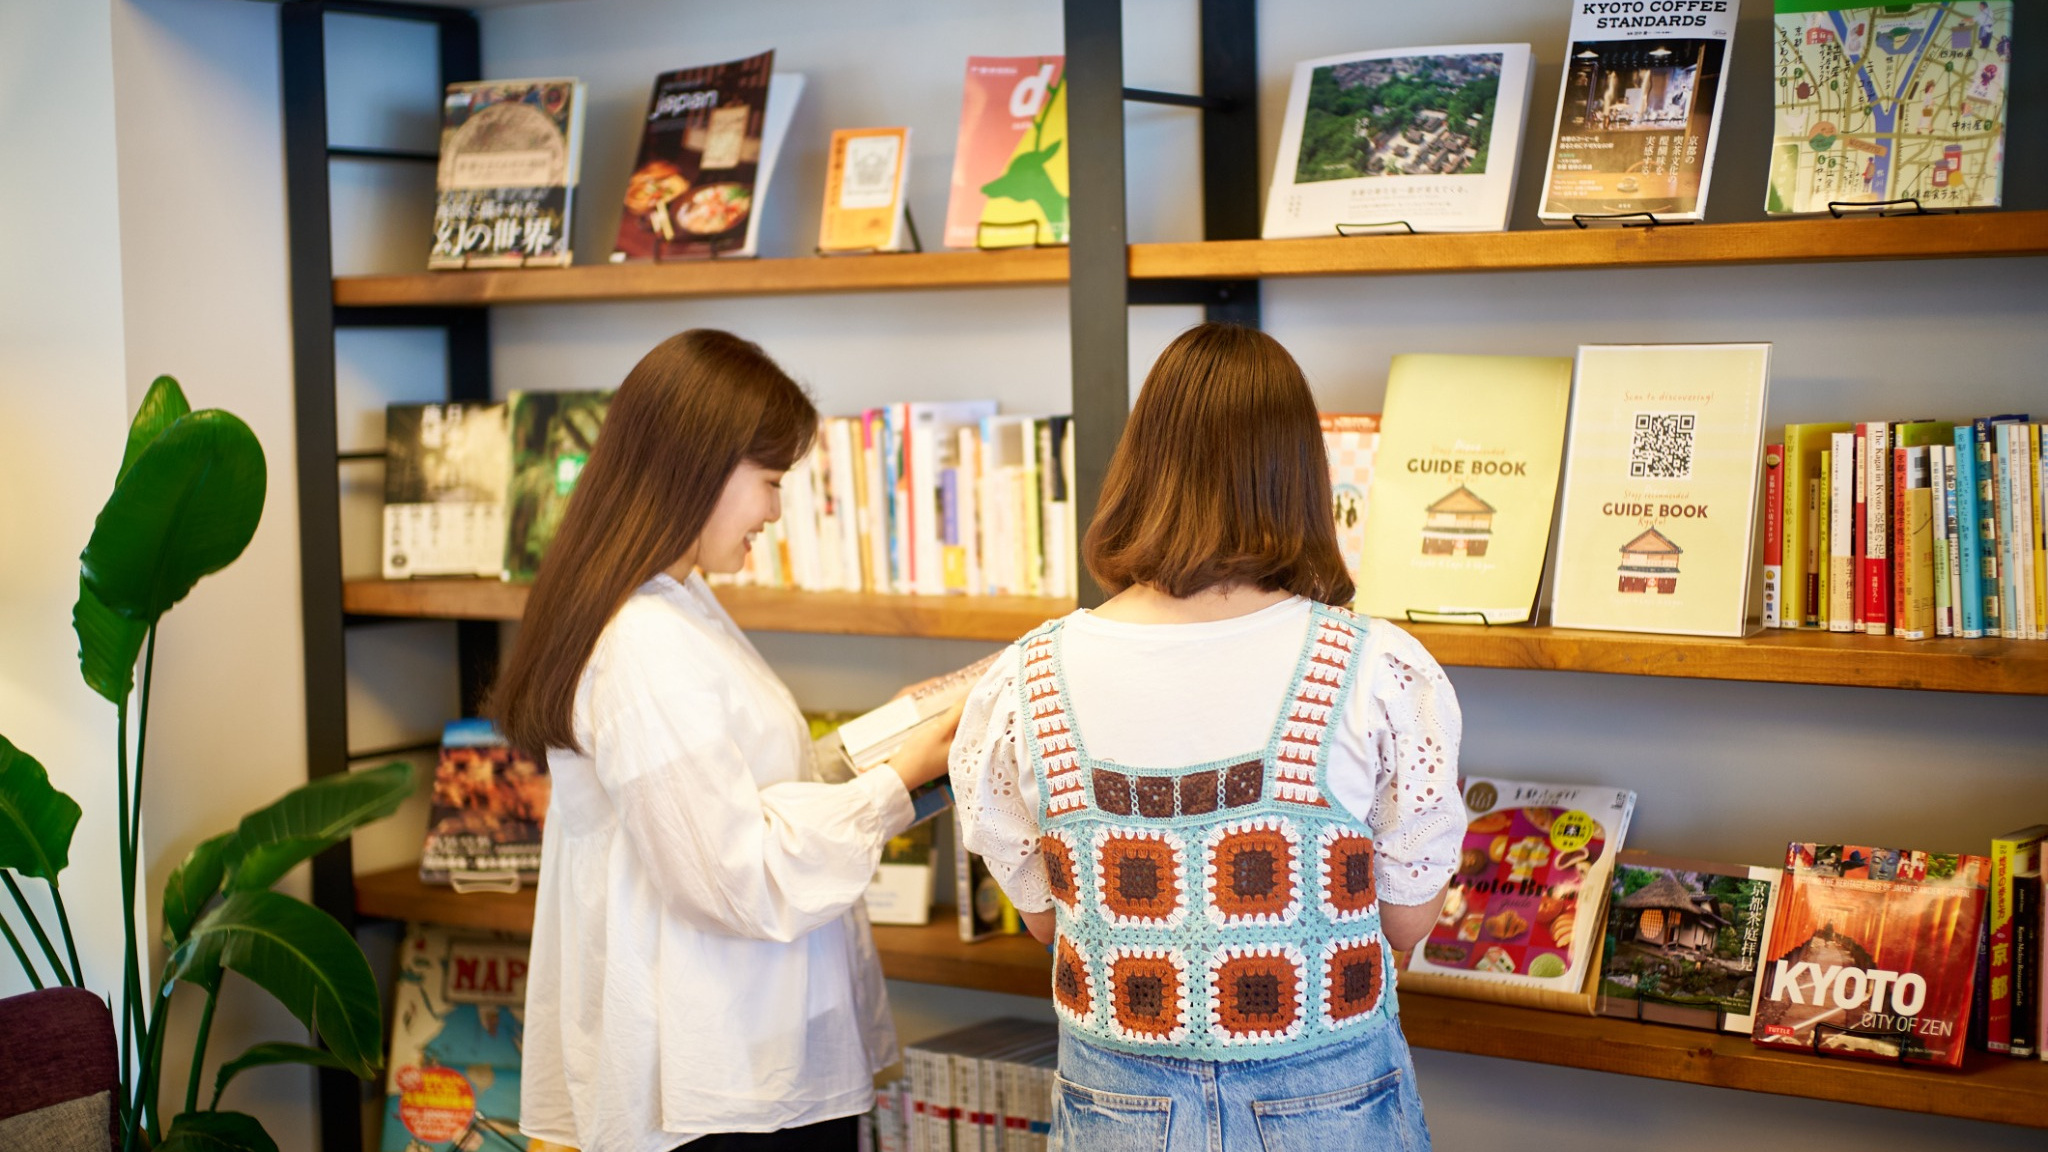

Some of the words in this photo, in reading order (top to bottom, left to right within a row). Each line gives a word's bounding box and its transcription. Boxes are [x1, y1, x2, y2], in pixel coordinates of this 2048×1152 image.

[1583, 2, 1644, 15] KYOTO
[1650, 1, 1727, 12] COFFEE
[1597, 15, 1707, 28] STANDARDS
[1009, 64, 1054, 117] d
[1952, 120, 1982, 131] 中村屋
[1668, 135, 1684, 183] 喫茶文化の
[1685, 135, 1699, 164] 京都の
[1875, 430, 1884, 446] The
[1407, 459, 1464, 474] GUIDE
[1471, 460, 1527, 477] BOOK
[1874, 448, 1884, 470] Kagai
[1875, 473, 1884, 482] in
[1874, 485, 1884, 510] Kyoto
[1602, 502, 1653, 517] GUIDE
[1659, 503, 1708, 518] BOOK
[1874, 512, 1885, 558] 京都の花
[1991, 942, 2009, 1000] 京都
[1770, 959, 1927, 1017] KYOTO
[1768, 1026, 1791, 1037] TUTTLE
[1861, 1012, 1895, 1030] CITY
[1896, 1016, 1919, 1032] OF
[1919, 1018, 1953, 1037] ZEN
